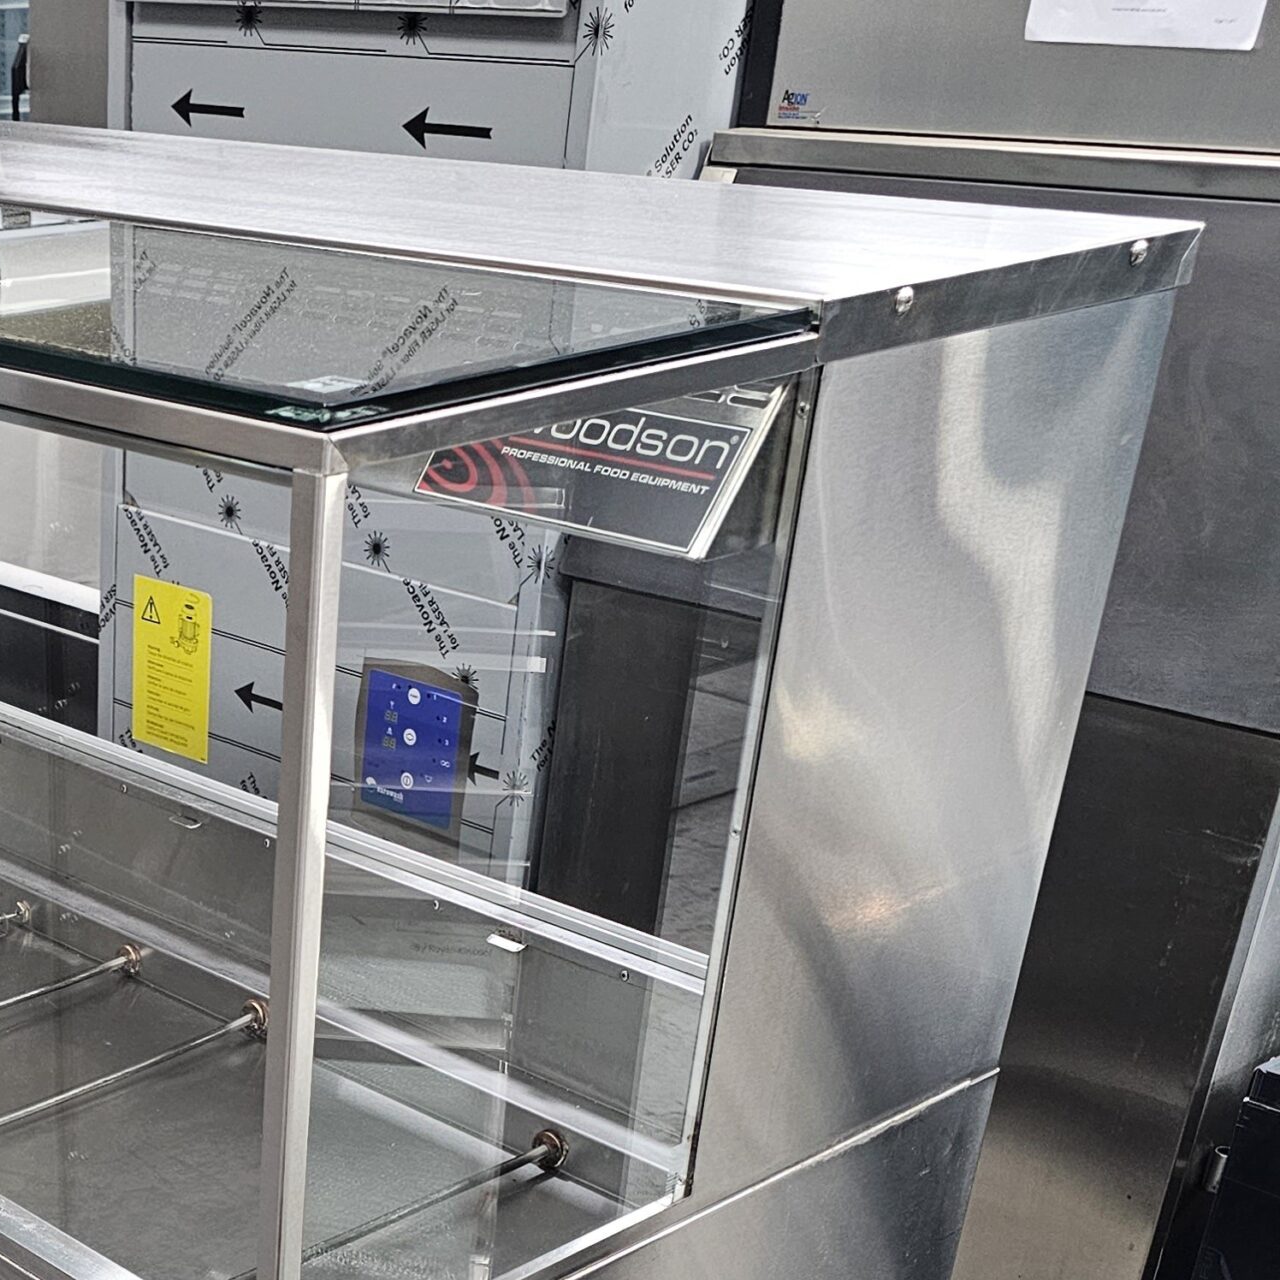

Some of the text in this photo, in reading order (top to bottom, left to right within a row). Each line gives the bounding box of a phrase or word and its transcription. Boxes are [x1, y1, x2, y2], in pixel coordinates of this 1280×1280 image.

[654, 114, 693, 173] Solution
[501, 446, 710, 496] PROFESSIONAL FOOD EQUIPMENT
[348, 502, 362, 528] The
[358, 501, 371, 519] for
[150, 554, 163, 578] The
[509, 541, 524, 569] The
[403, 577, 437, 634] Novace
[435, 633, 450, 659] The
[447, 633, 460, 650] for
